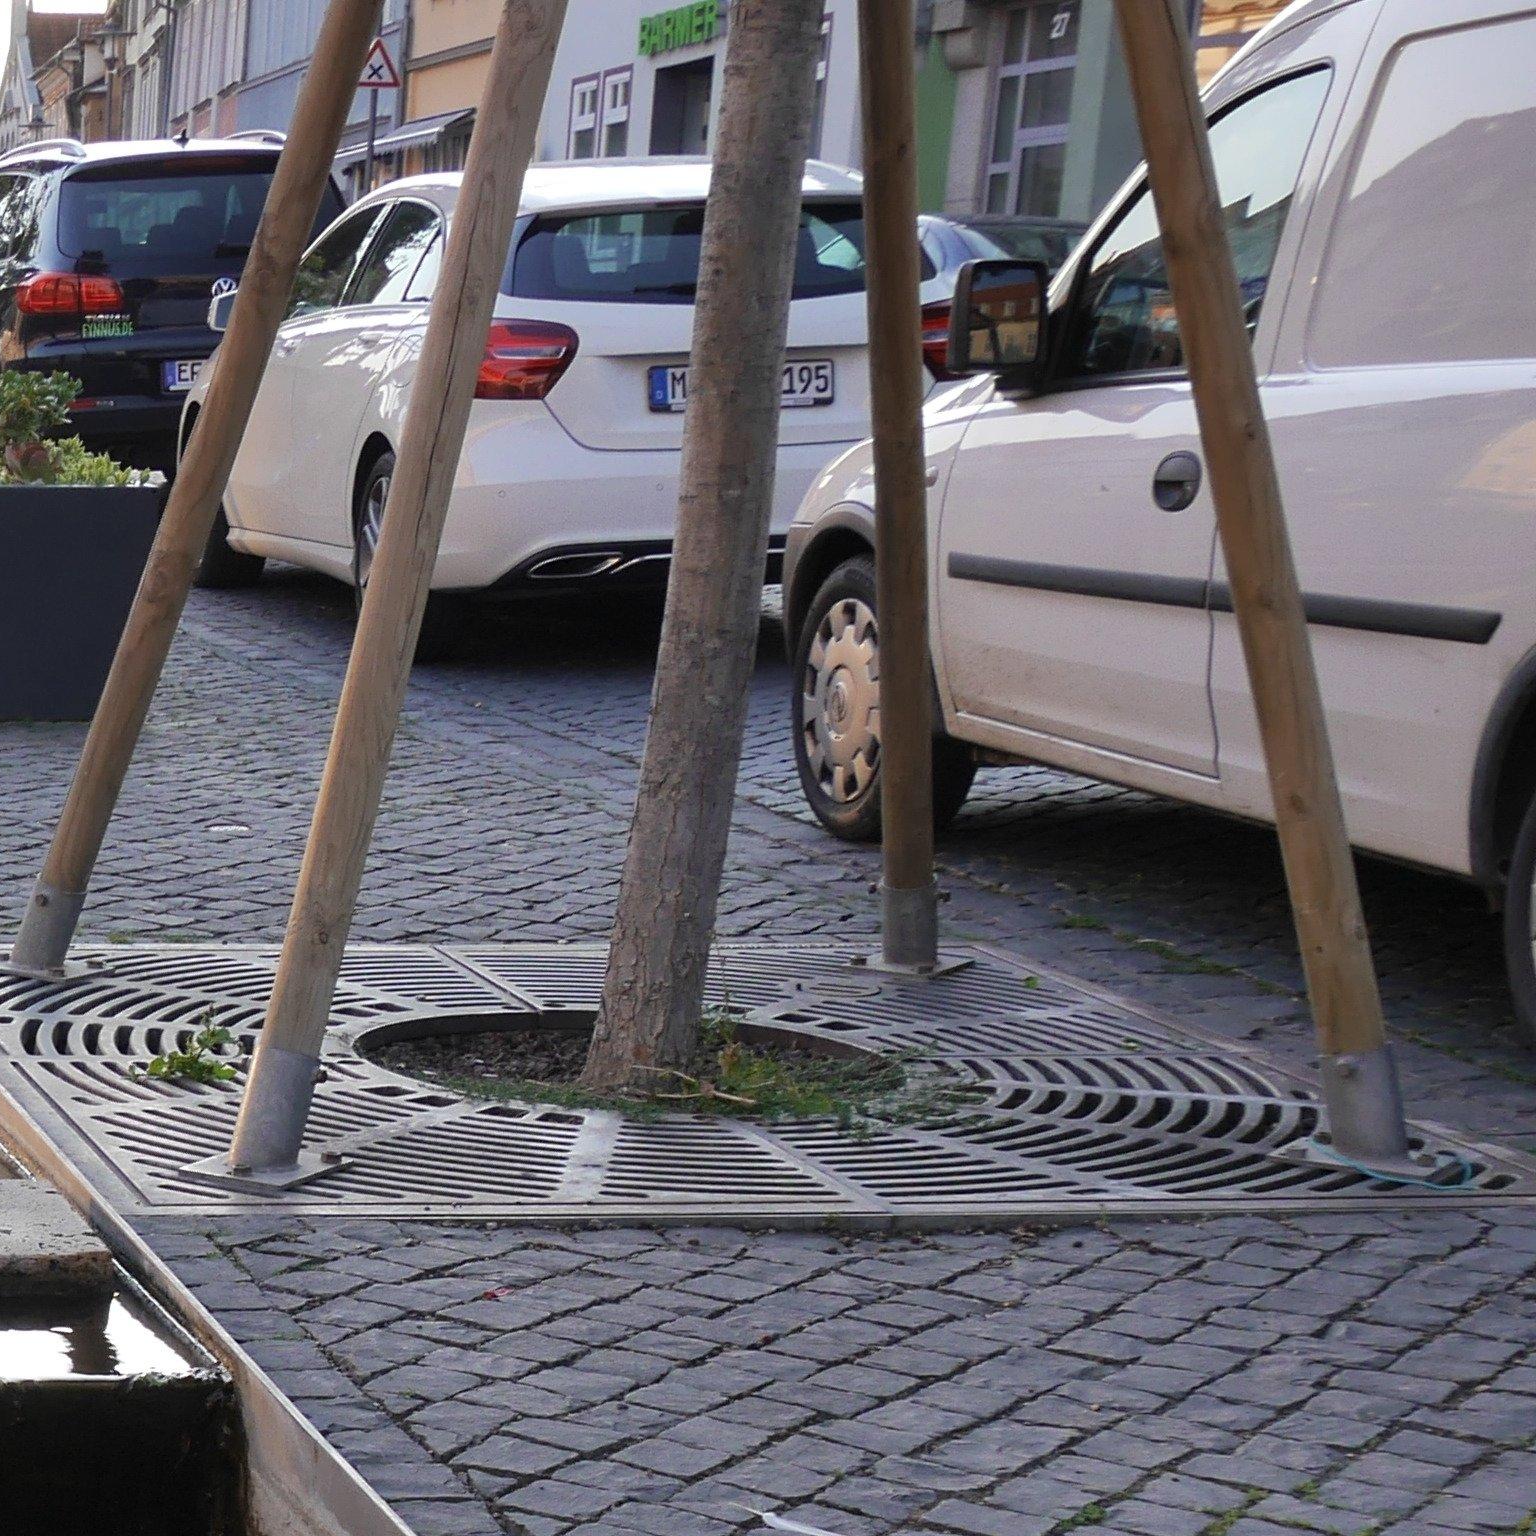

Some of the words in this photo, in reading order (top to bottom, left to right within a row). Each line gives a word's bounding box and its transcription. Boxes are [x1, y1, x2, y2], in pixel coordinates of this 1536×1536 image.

[637, 0, 720, 56] BARMER
[1050, 11, 1071, 40] 27
[782, 364, 829, 396] 195
